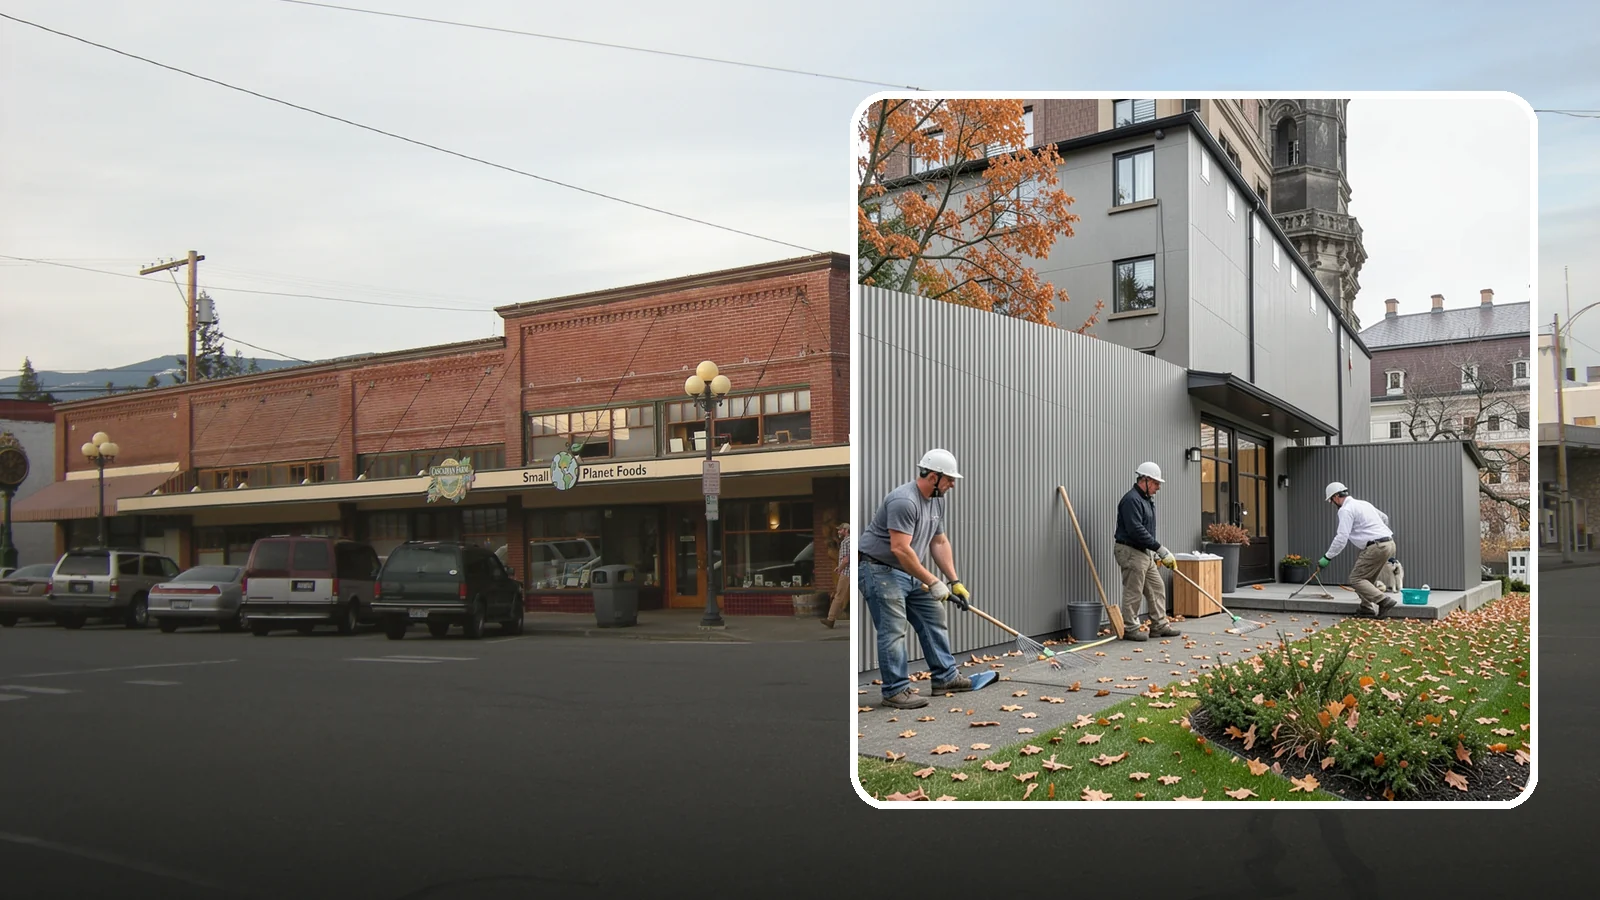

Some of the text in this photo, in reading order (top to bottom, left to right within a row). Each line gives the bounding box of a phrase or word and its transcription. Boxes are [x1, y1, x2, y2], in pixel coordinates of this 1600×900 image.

[523, 465, 647, 483] Small Planet Foods
